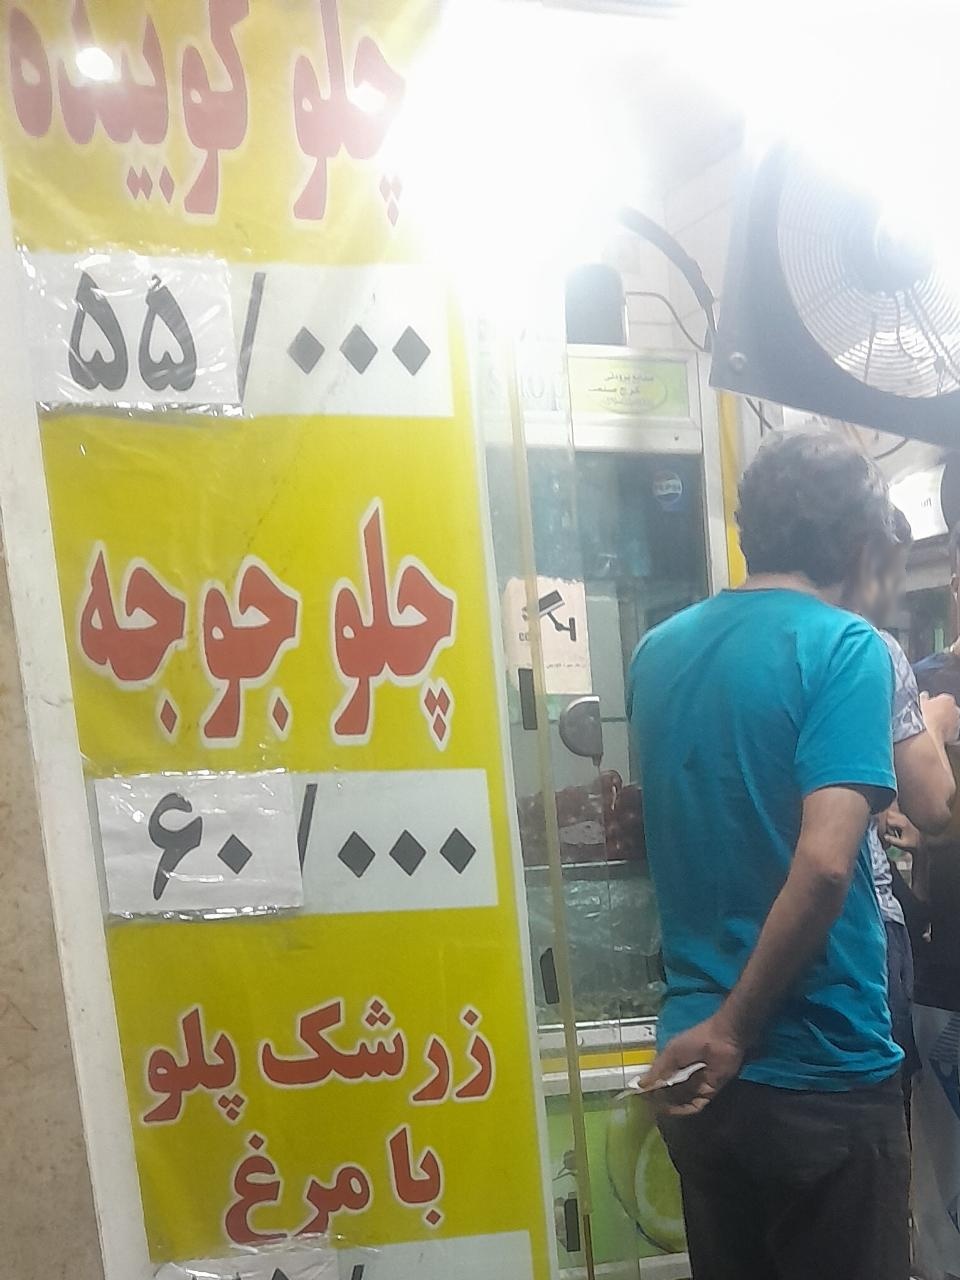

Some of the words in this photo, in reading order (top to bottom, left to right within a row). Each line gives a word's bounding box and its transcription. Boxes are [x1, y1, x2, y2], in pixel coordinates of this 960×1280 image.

[9, 0, 249, 214] کوبیده
[293, 0, 407, 226] چلو
[69, 272, 431, 402] ۵۵/۰۰۰
[80, 551, 298, 738] جوجه
[334, 505, 454, 742] چلو
[148, 783, 477, 900] ۶۰/۰۰۰
[143, 1008, 241, 1122] پلو
[261, 1000, 493, 1100] زرشک
[224, 1133, 370, 1243] مرغ
[390, 1129, 443, 1225] با
